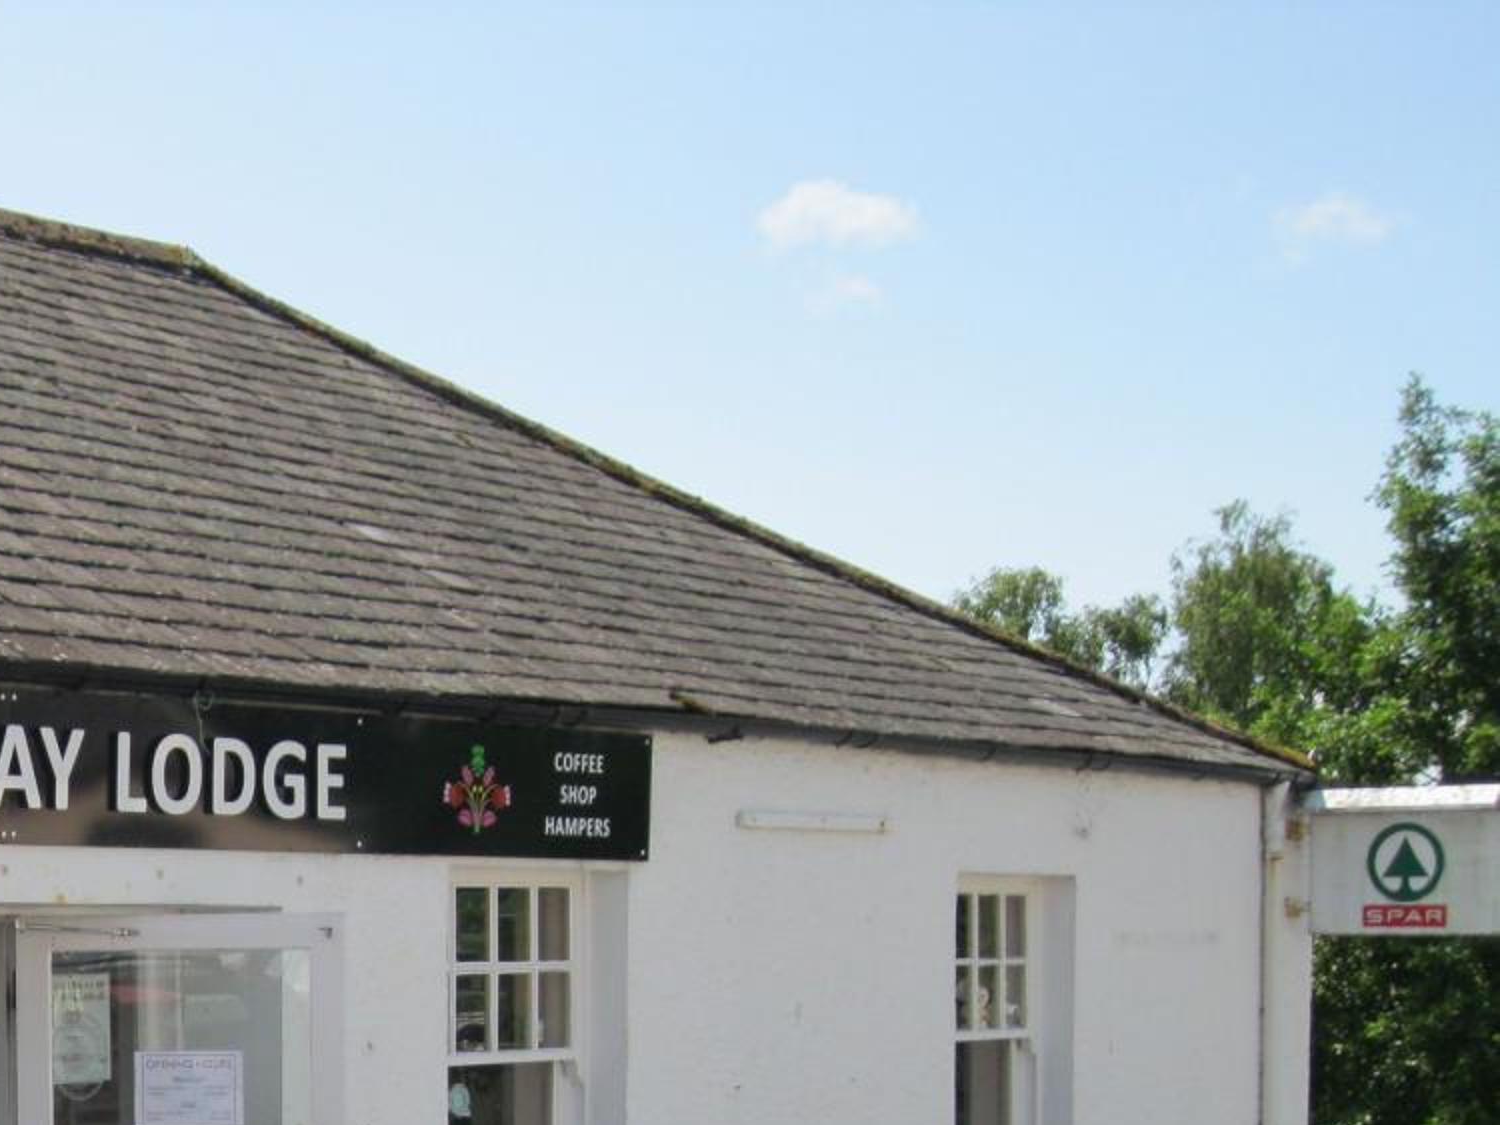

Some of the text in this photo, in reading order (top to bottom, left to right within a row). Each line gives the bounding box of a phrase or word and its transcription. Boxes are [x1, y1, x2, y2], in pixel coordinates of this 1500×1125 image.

[554, 752, 604, 774] COFFEE
[116, 731, 347, 821] LODGE
[560, 784, 597, 805] SHOP
[544, 816, 611, 838] HAMPERS
[1366, 908, 1443, 924] SPAR
